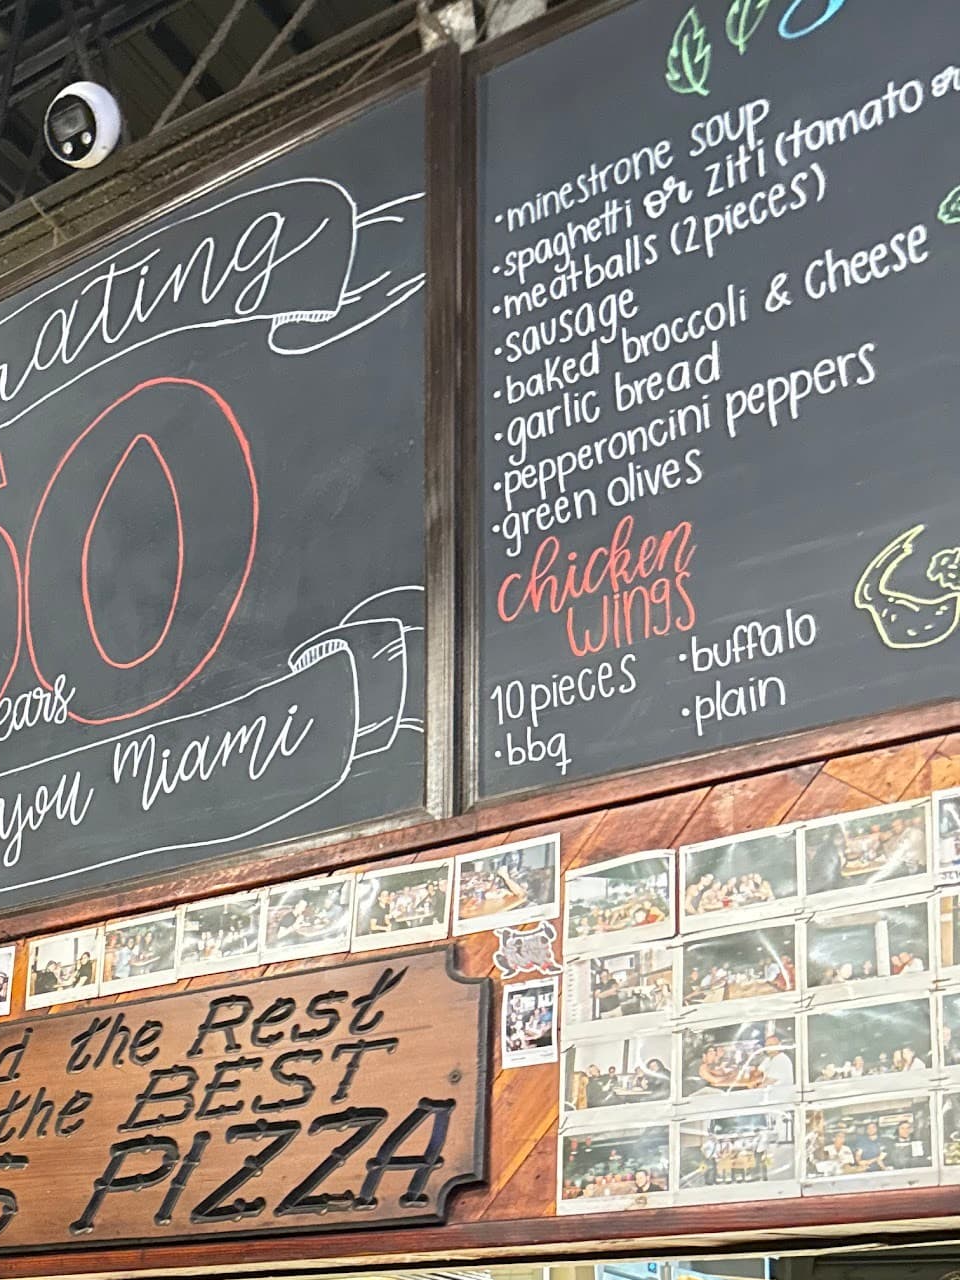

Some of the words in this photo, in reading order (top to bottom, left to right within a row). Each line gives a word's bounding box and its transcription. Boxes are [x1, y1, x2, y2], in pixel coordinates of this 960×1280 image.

[504, 199, 634, 284] spaghetti
[644, 177, 693, 219] or
[705, 136, 767, 197] ziti
[776, 80, 924, 165] (tomato
[506, 140, 673, 232] minestrone
[690, 99, 769, 157] soup
[504, 234, 658, 319] meatballs
[505, 288, 639, 363] sausage
[506, 341, 600, 404] baked
[621, 284, 746, 364] broccoli
[764, 272, 792, 313] &
[504, 398, 711, 511] pepperoncini
[727, 343, 876, 437] peppers
[506, 391, 600, 465] garlic
[615, 341, 721, 412] bread
[501, 488, 596, 557] green
[607, 448, 704, 508] olives
[498, 515, 698, 622] chicken
[566, 571, 697, 657] wings
[691, 609, 816, 671] buffalo
[506, 732, 573, 776] bbq
[695, 676, 786, 735] plain
[67, 1014, 166, 1073] the
[186, 965, 413, 1058] Rest
[117, 1038, 399, 1133] BEST
[70, 1097, 456, 1236] PIZZA
